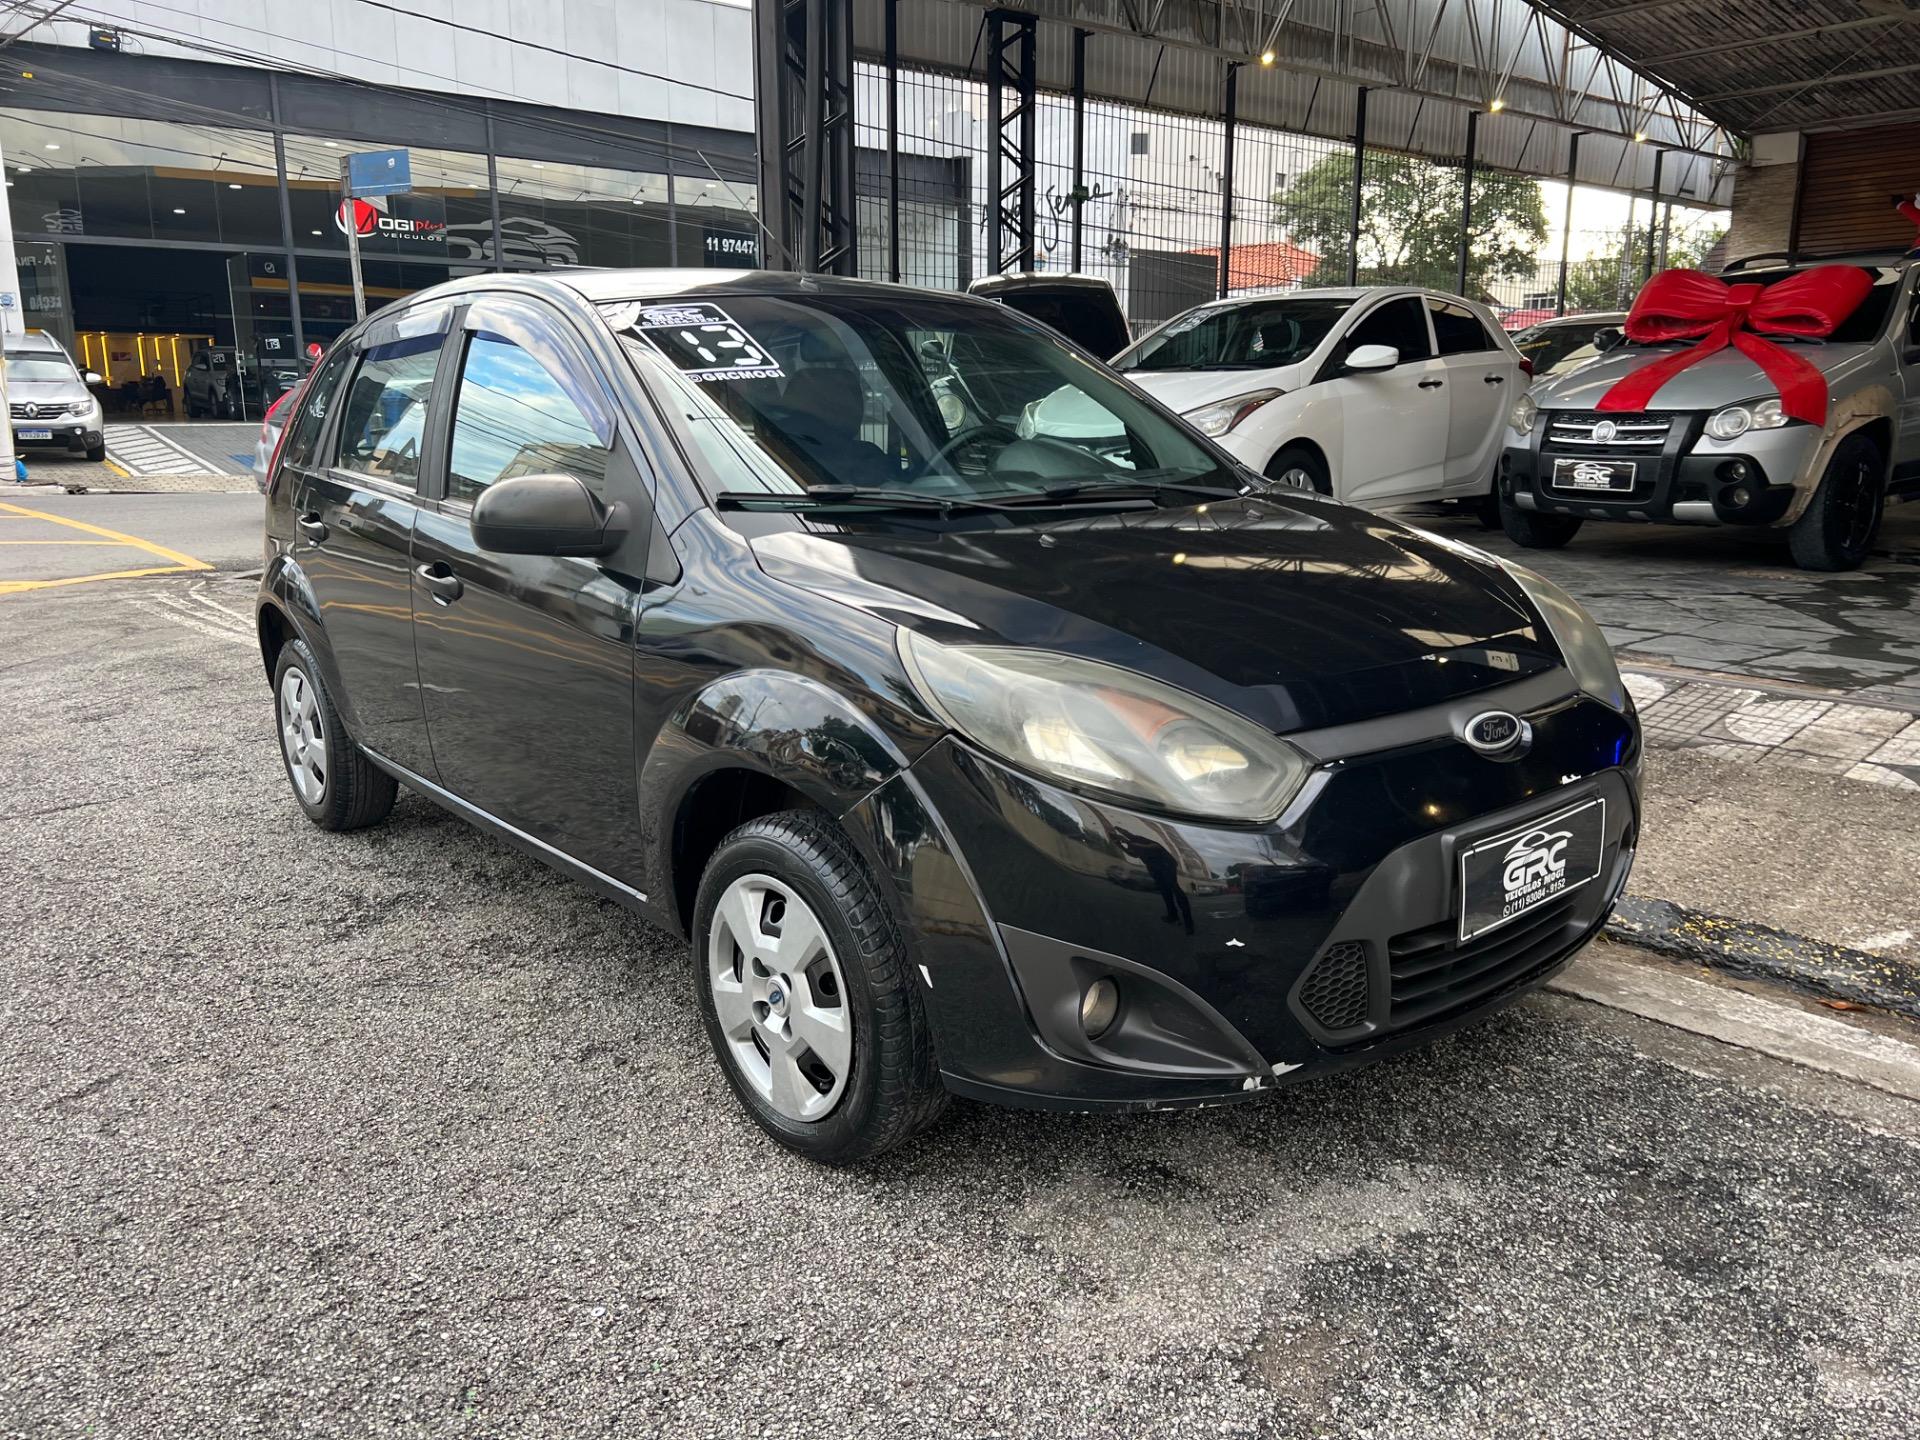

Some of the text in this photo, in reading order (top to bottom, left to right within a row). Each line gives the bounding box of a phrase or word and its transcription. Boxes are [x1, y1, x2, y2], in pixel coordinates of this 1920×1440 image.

[706, 237, 719, 251] 11
[680, 325, 763, 366] 13
[1573, 469, 1611, 481] GRC
[1483, 719, 1510, 741] Ford
[1503, 838, 1568, 892] GRC
[1543, 867, 1565, 885] MOGI
[1511, 897, 1525, 914] (11)
